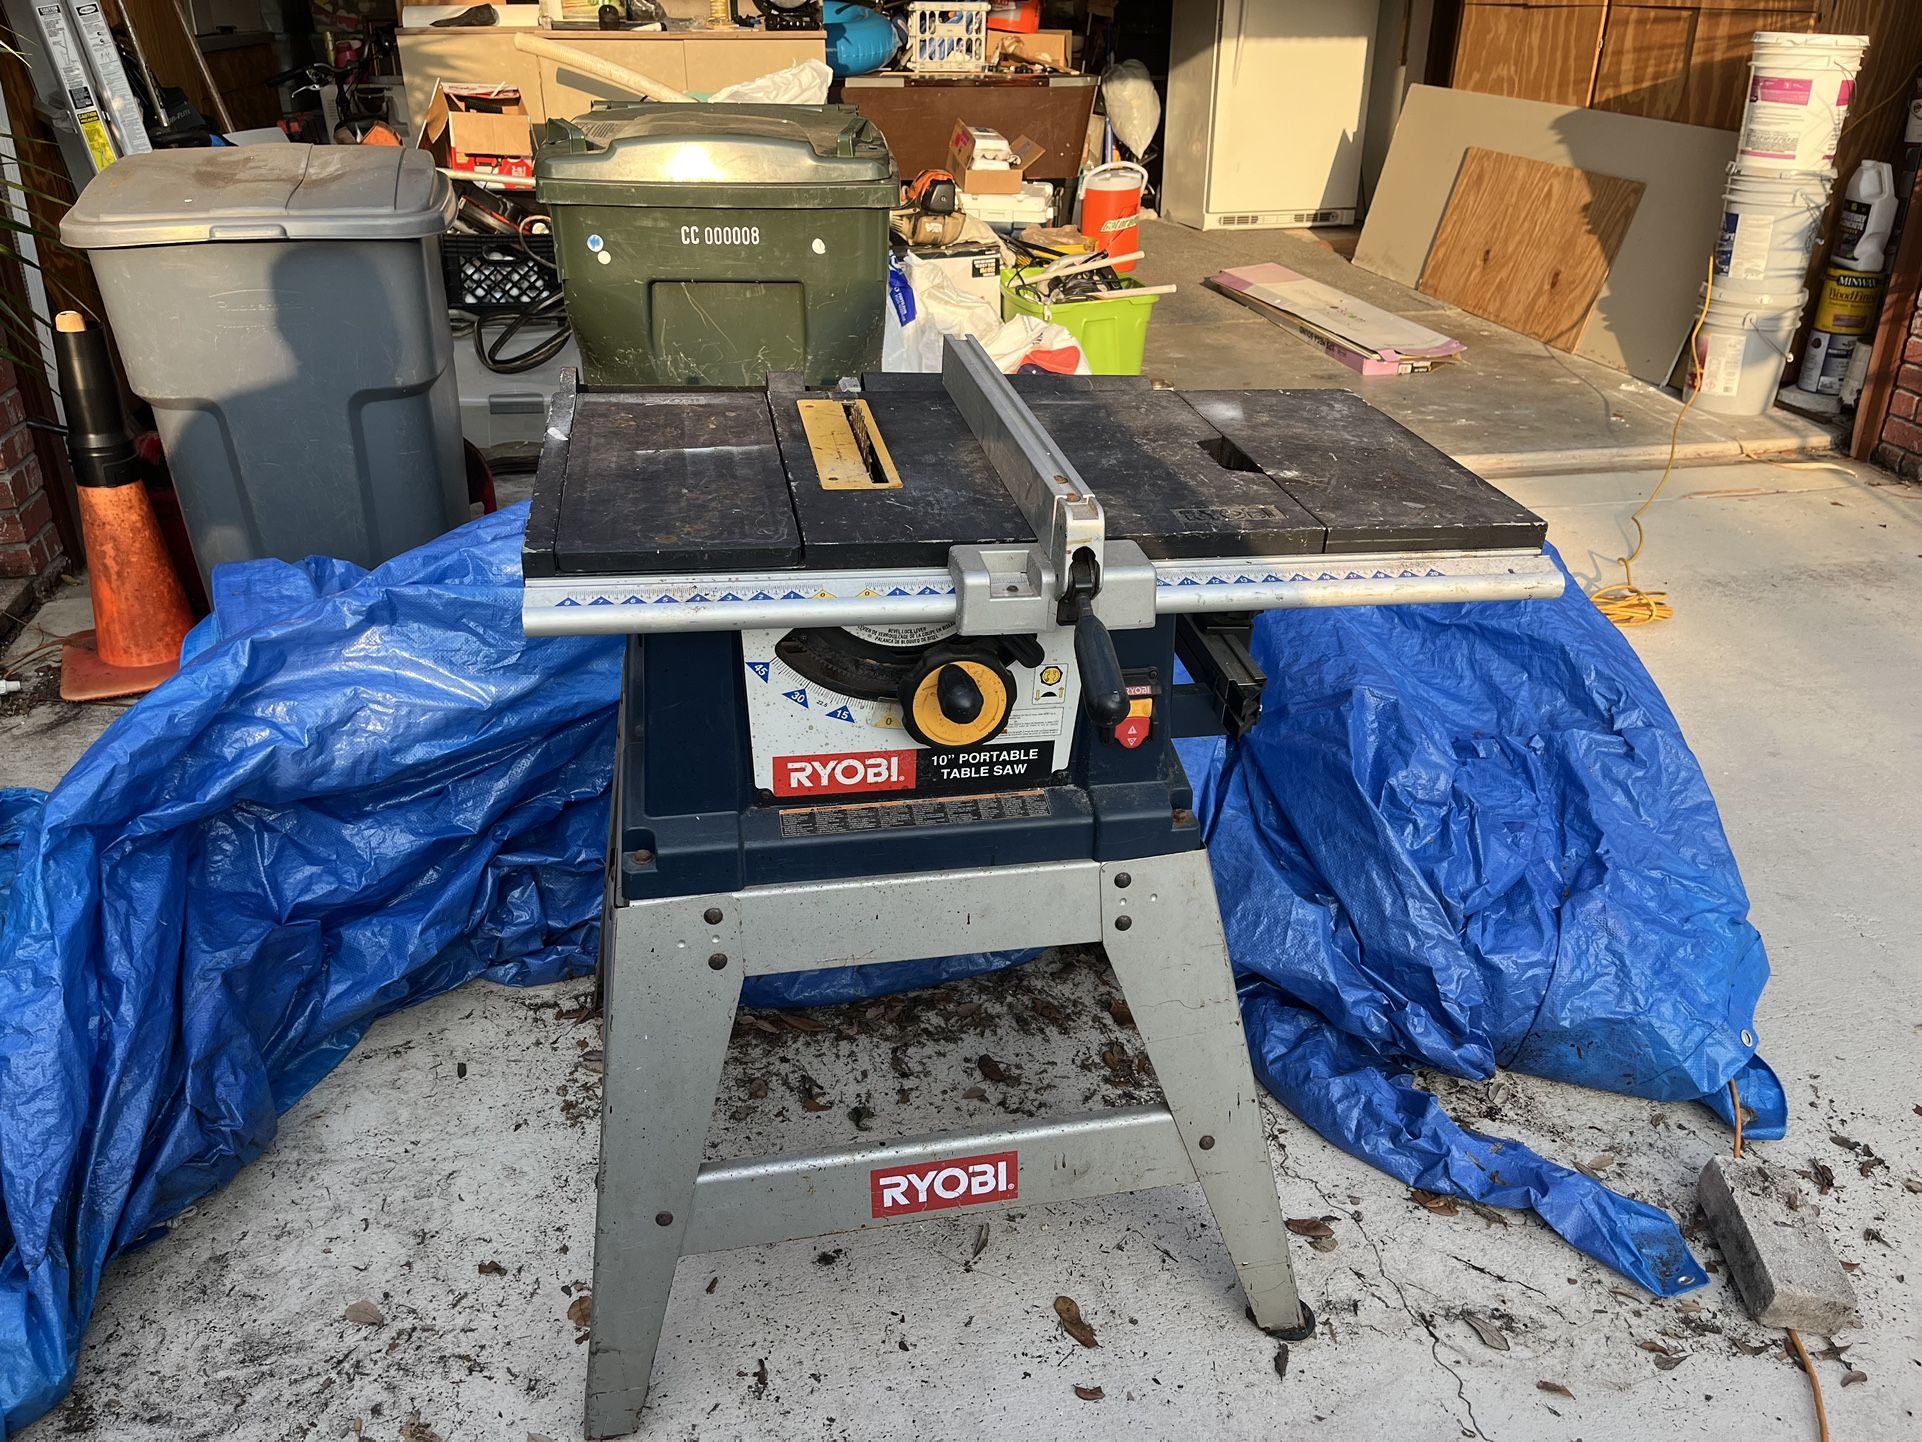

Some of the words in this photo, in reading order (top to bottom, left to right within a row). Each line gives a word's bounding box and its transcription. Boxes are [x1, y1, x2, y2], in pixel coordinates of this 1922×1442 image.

[1103, 218, 1137, 230] Gatora
[681, 226, 699, 245] CC
[704, 227, 760, 245] 000008
[753, 663, 768, 677] 45
[791, 691, 805, 703] 30
[1126, 686, 1152, 696] RYOBI
[816, 700, 828, 708] 22.5
[836, 710, 849, 720] 15
[885, 717, 893, 726] 0
[959, 749, 1039, 765] PORTABLE
[786, 756, 900, 788] RYOBI
[941, 766, 990, 780] TABLE
[993, 763, 1028, 776] SAW
[879, 1160, 1008, 1208] RYOBI
